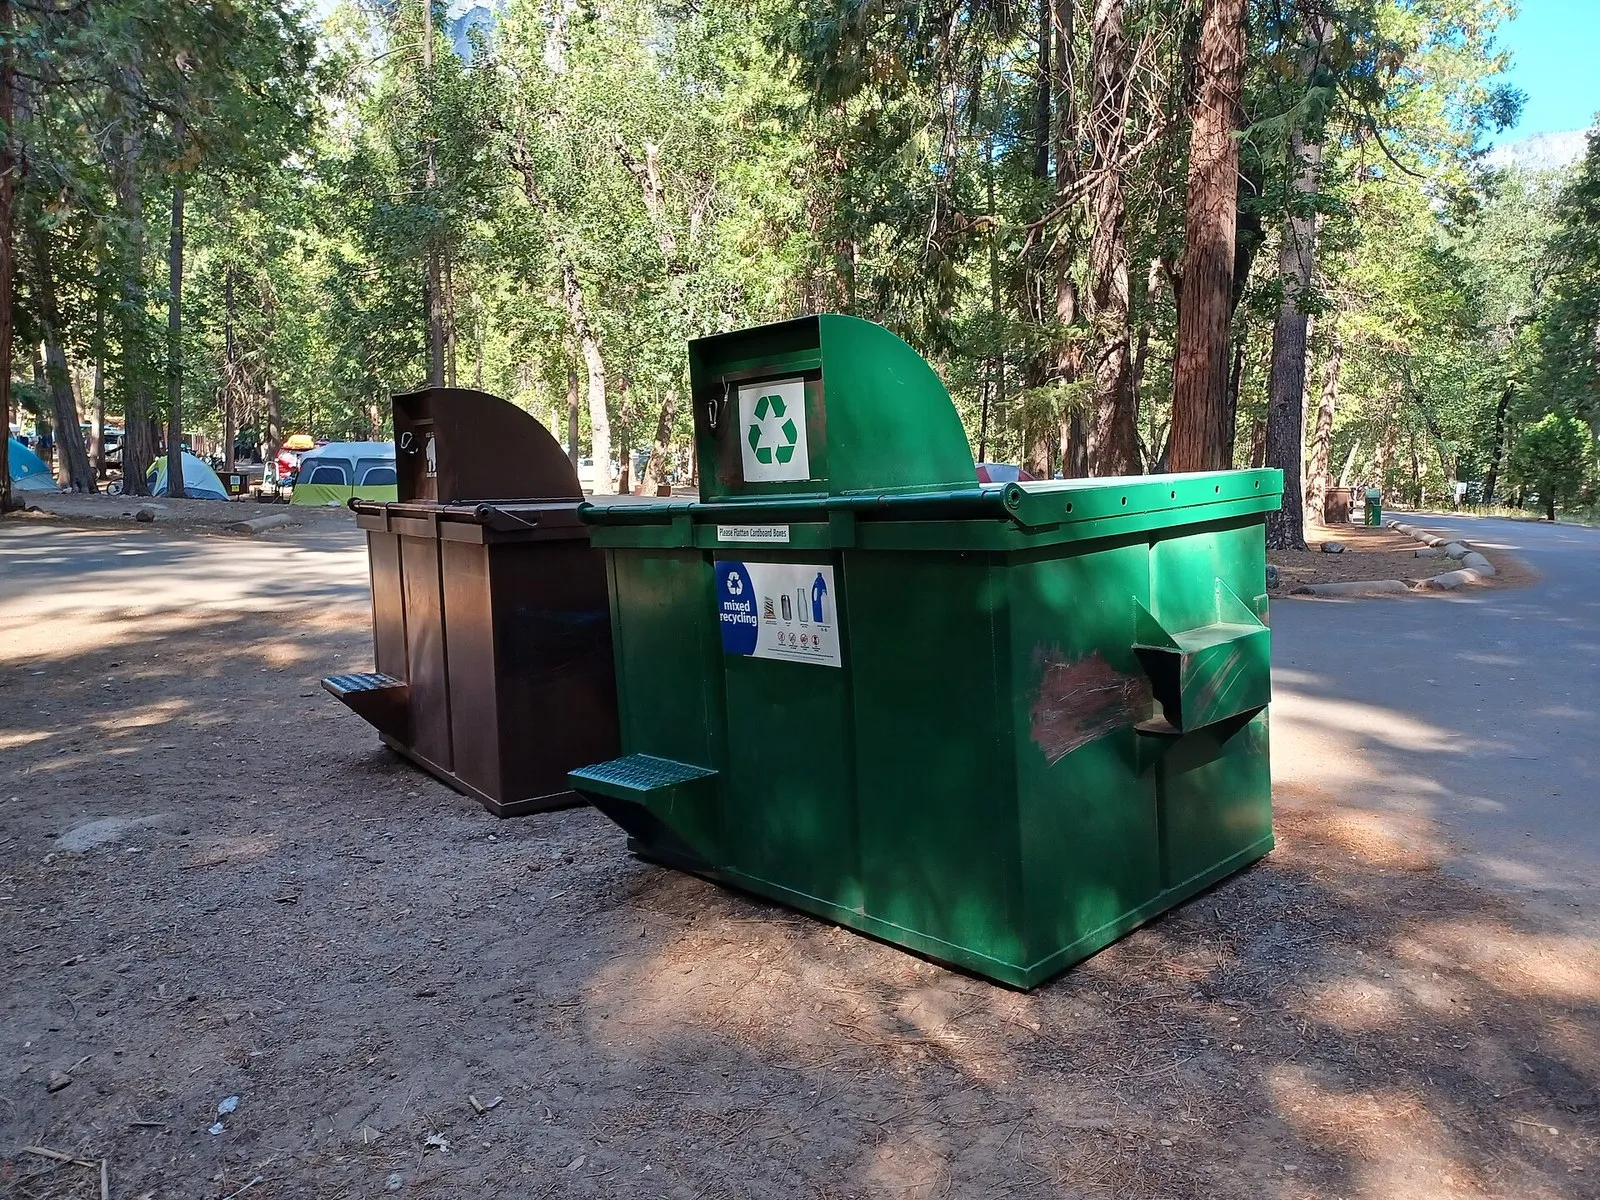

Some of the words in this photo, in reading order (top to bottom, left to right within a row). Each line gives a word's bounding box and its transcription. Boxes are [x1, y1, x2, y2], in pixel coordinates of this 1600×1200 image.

[720, 528, 733, 536] Please
[734, 528, 750, 536] Flatten
[750, 528, 772, 537] Cardboard
[773, 528, 786, 538] Boxes
[723, 599, 750, 612] mixed
[720, 612, 758, 627] recycling
